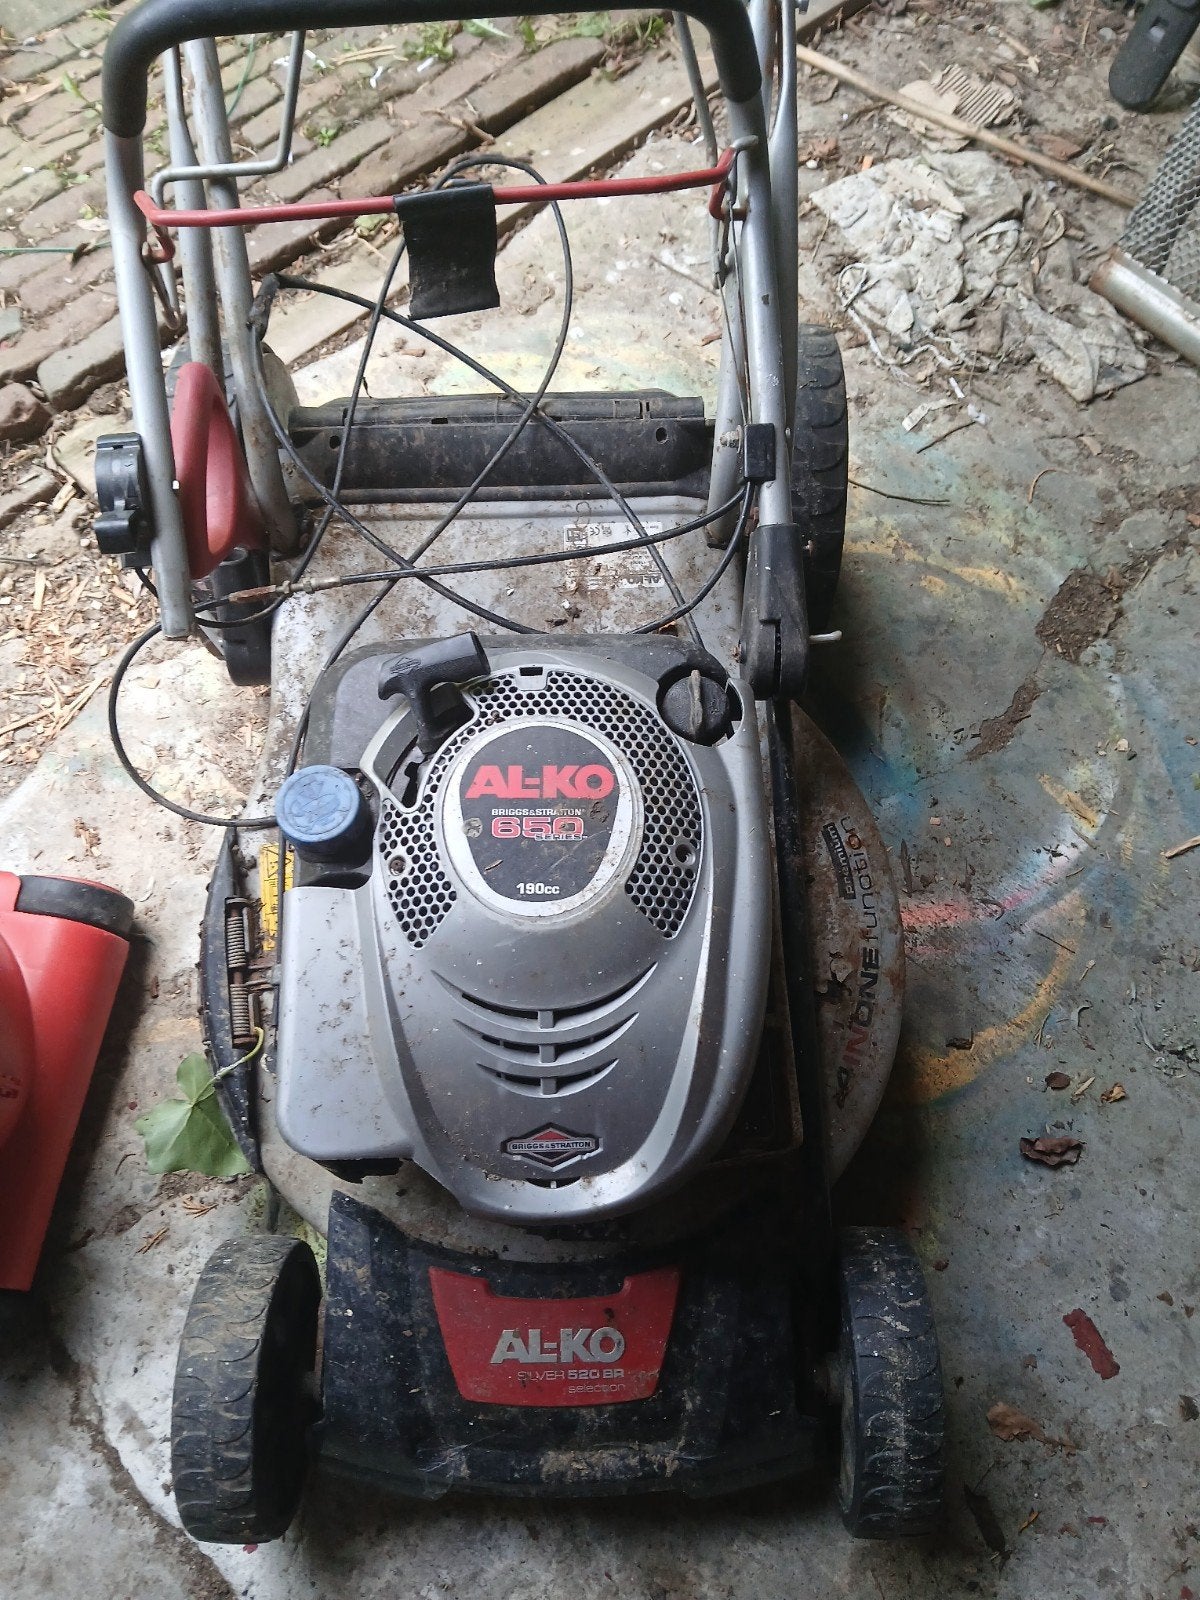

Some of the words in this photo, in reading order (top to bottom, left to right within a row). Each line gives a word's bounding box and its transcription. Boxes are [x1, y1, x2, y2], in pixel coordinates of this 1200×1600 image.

[465, 764, 615, 800] AL-KO
[491, 816, 584, 838] 650
[824, 824, 855, 895] premium
[516, 882, 560, 895] 190cc
[490, 1327, 626, 1364] AL-KO
[517, 1369, 566, 1381] SILVER
[567, 1368, 601, 1380] 520
[602, 1368, 625, 1379] BR
